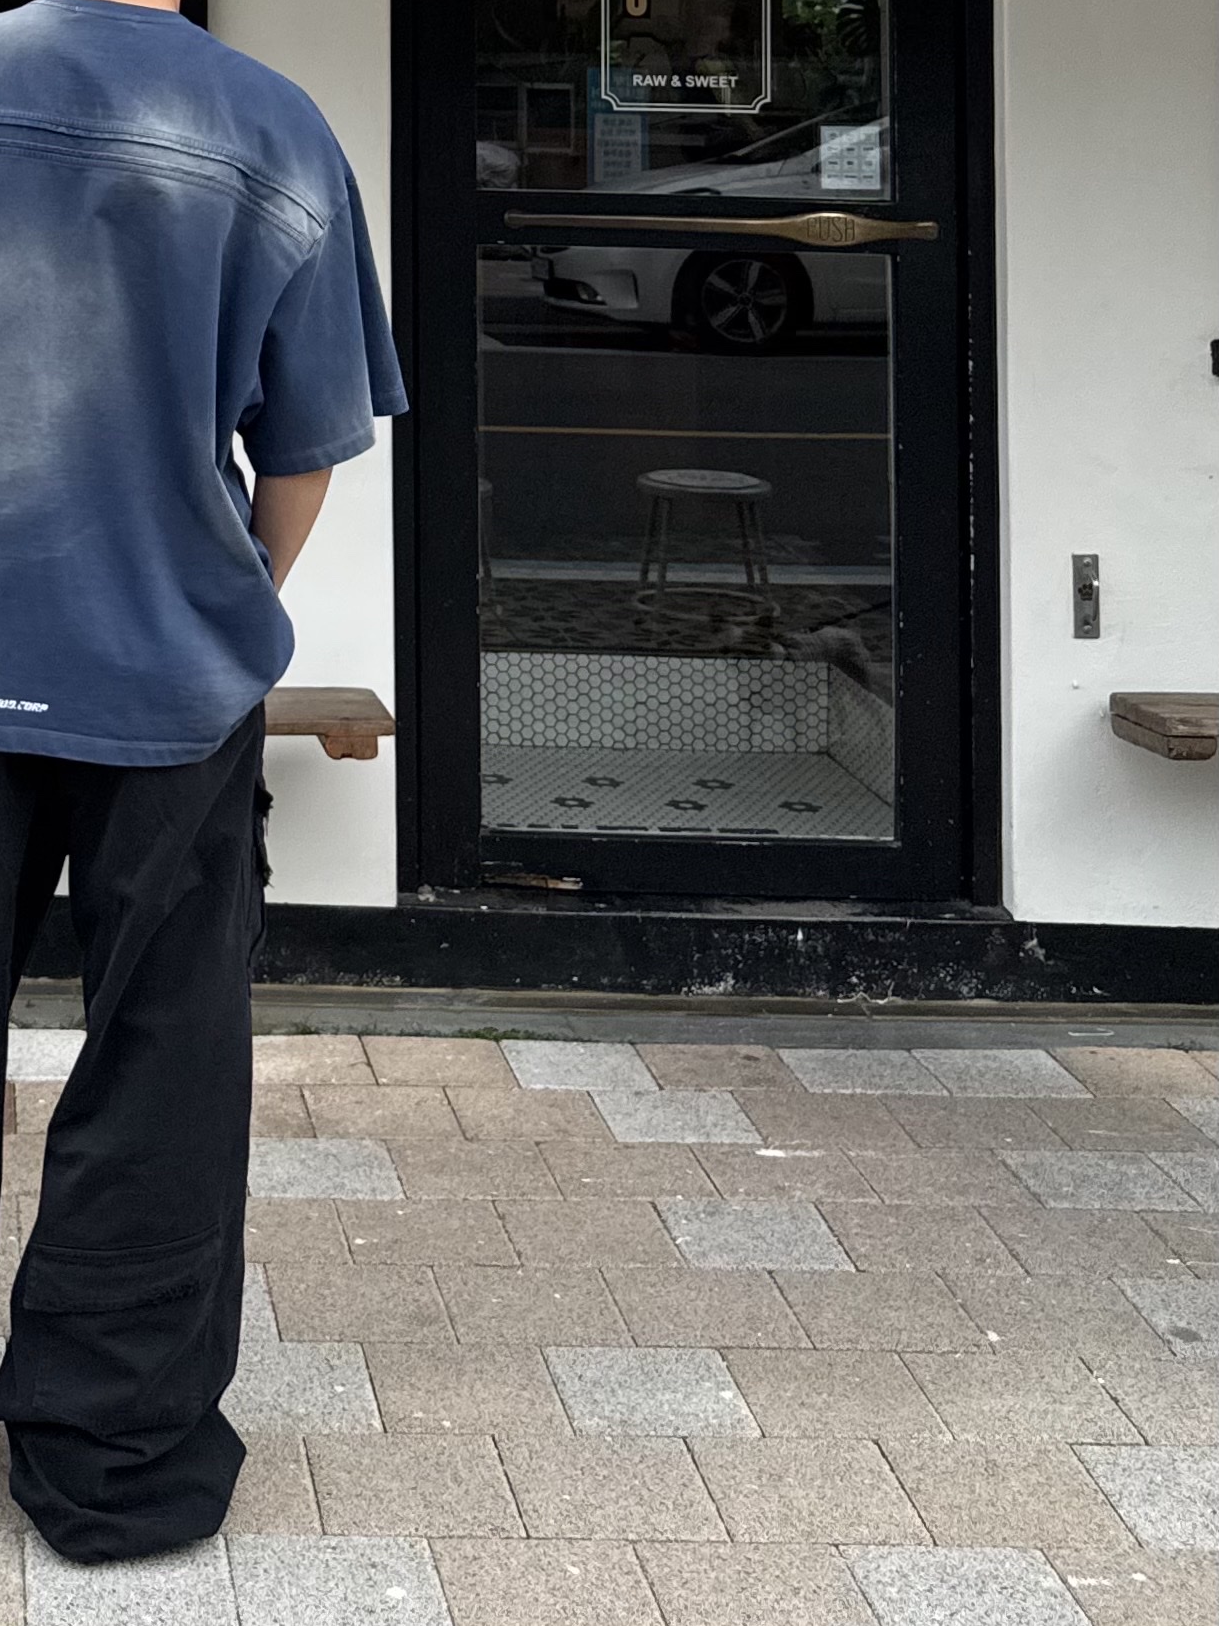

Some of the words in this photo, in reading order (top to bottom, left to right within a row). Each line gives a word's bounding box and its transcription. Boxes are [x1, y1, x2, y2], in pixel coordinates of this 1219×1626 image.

[632, 75, 668, 87] RAW
[671, 75, 682, 87] &
[685, 75, 738, 88] SWEET
[807, 216, 855, 242] PUSH
